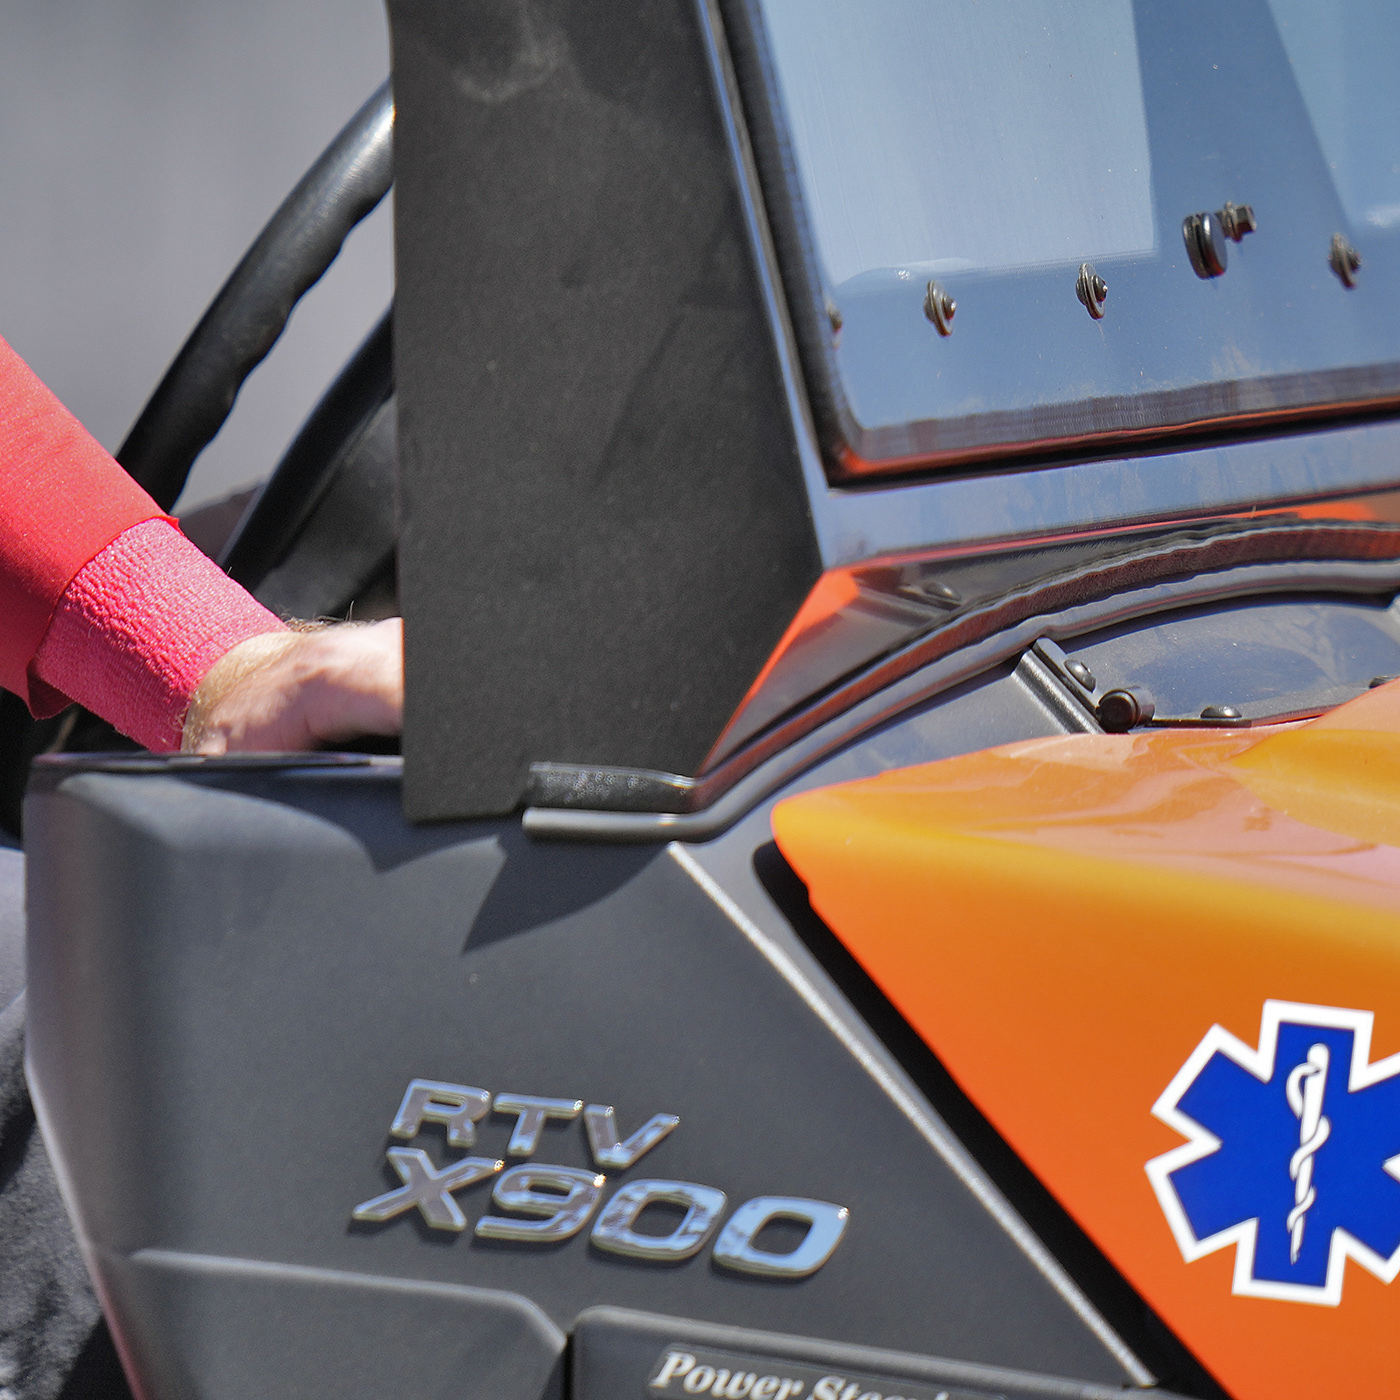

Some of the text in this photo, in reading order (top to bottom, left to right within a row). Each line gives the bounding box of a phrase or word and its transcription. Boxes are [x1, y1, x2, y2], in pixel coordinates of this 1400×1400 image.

[390, 1078, 682, 1170] RTV
[352, 1146, 850, 1279] X900
[652, 1350, 804, 1400] Power
